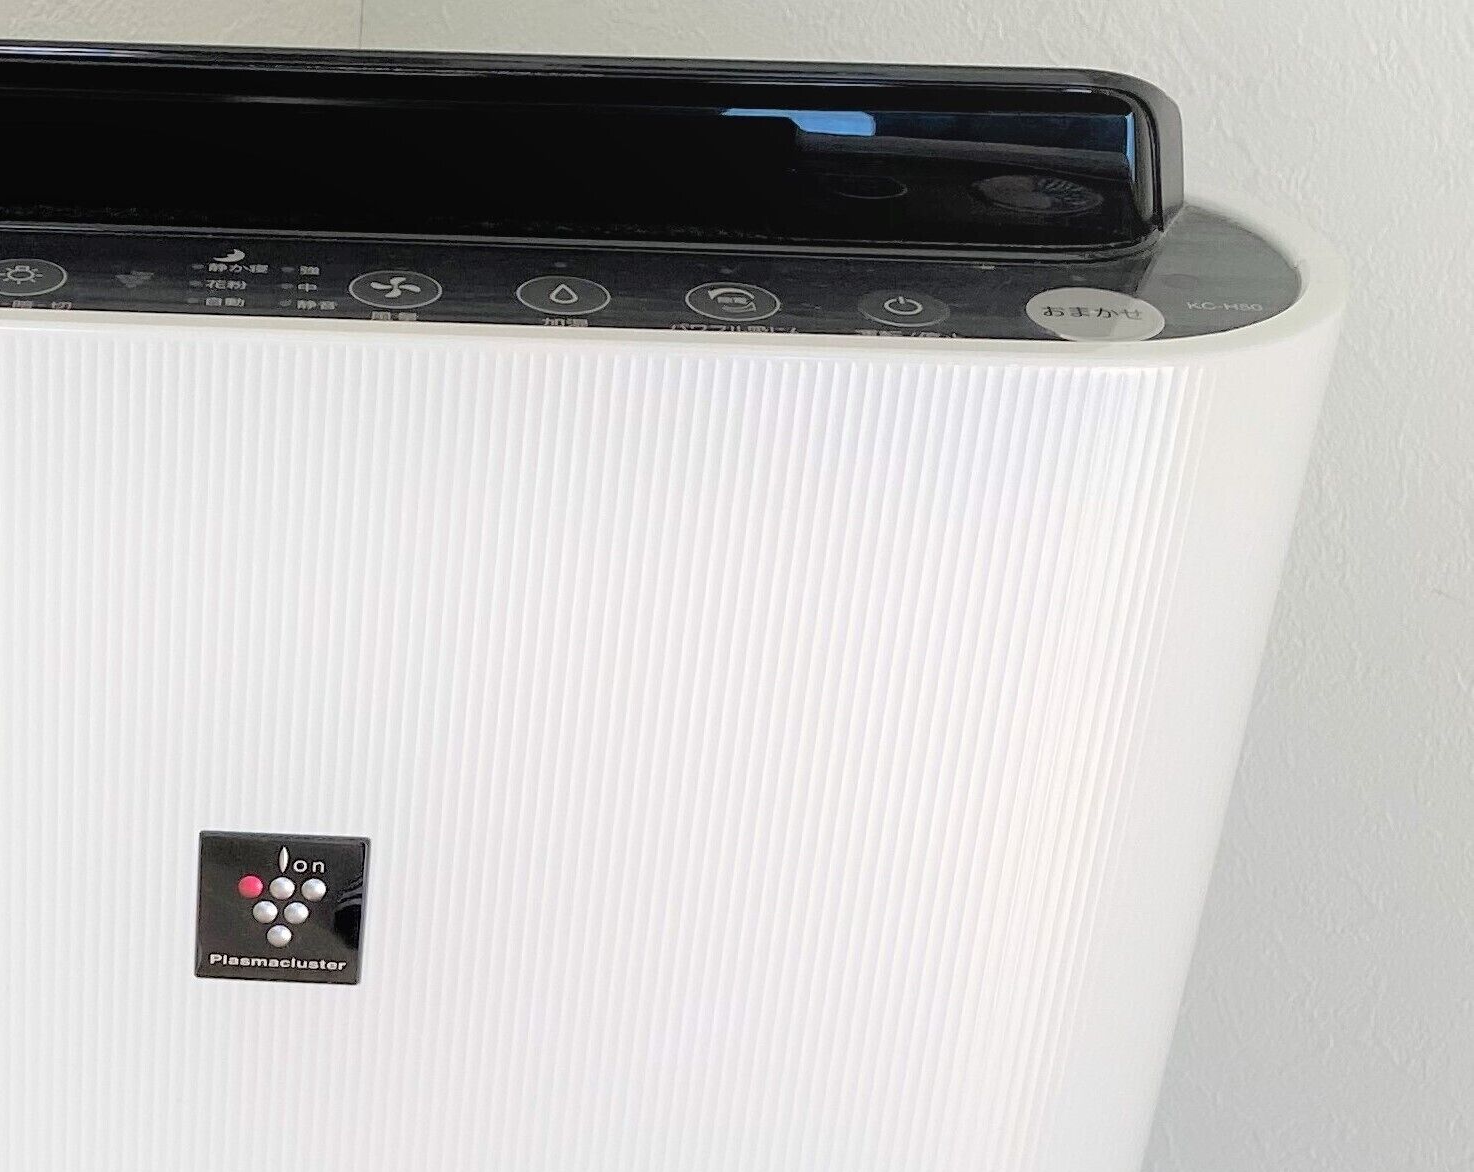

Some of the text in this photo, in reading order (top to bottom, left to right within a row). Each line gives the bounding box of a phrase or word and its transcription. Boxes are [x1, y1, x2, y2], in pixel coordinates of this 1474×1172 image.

[205, 279, 247, 291] 花粉
[297, 283, 318, 292] 中
[205, 297, 246, 308] 自動
[1041, 306, 1144, 321] おまかせ
[278, 846, 325, 874] Ion
[209, 953, 347, 971] Plasmacluster
